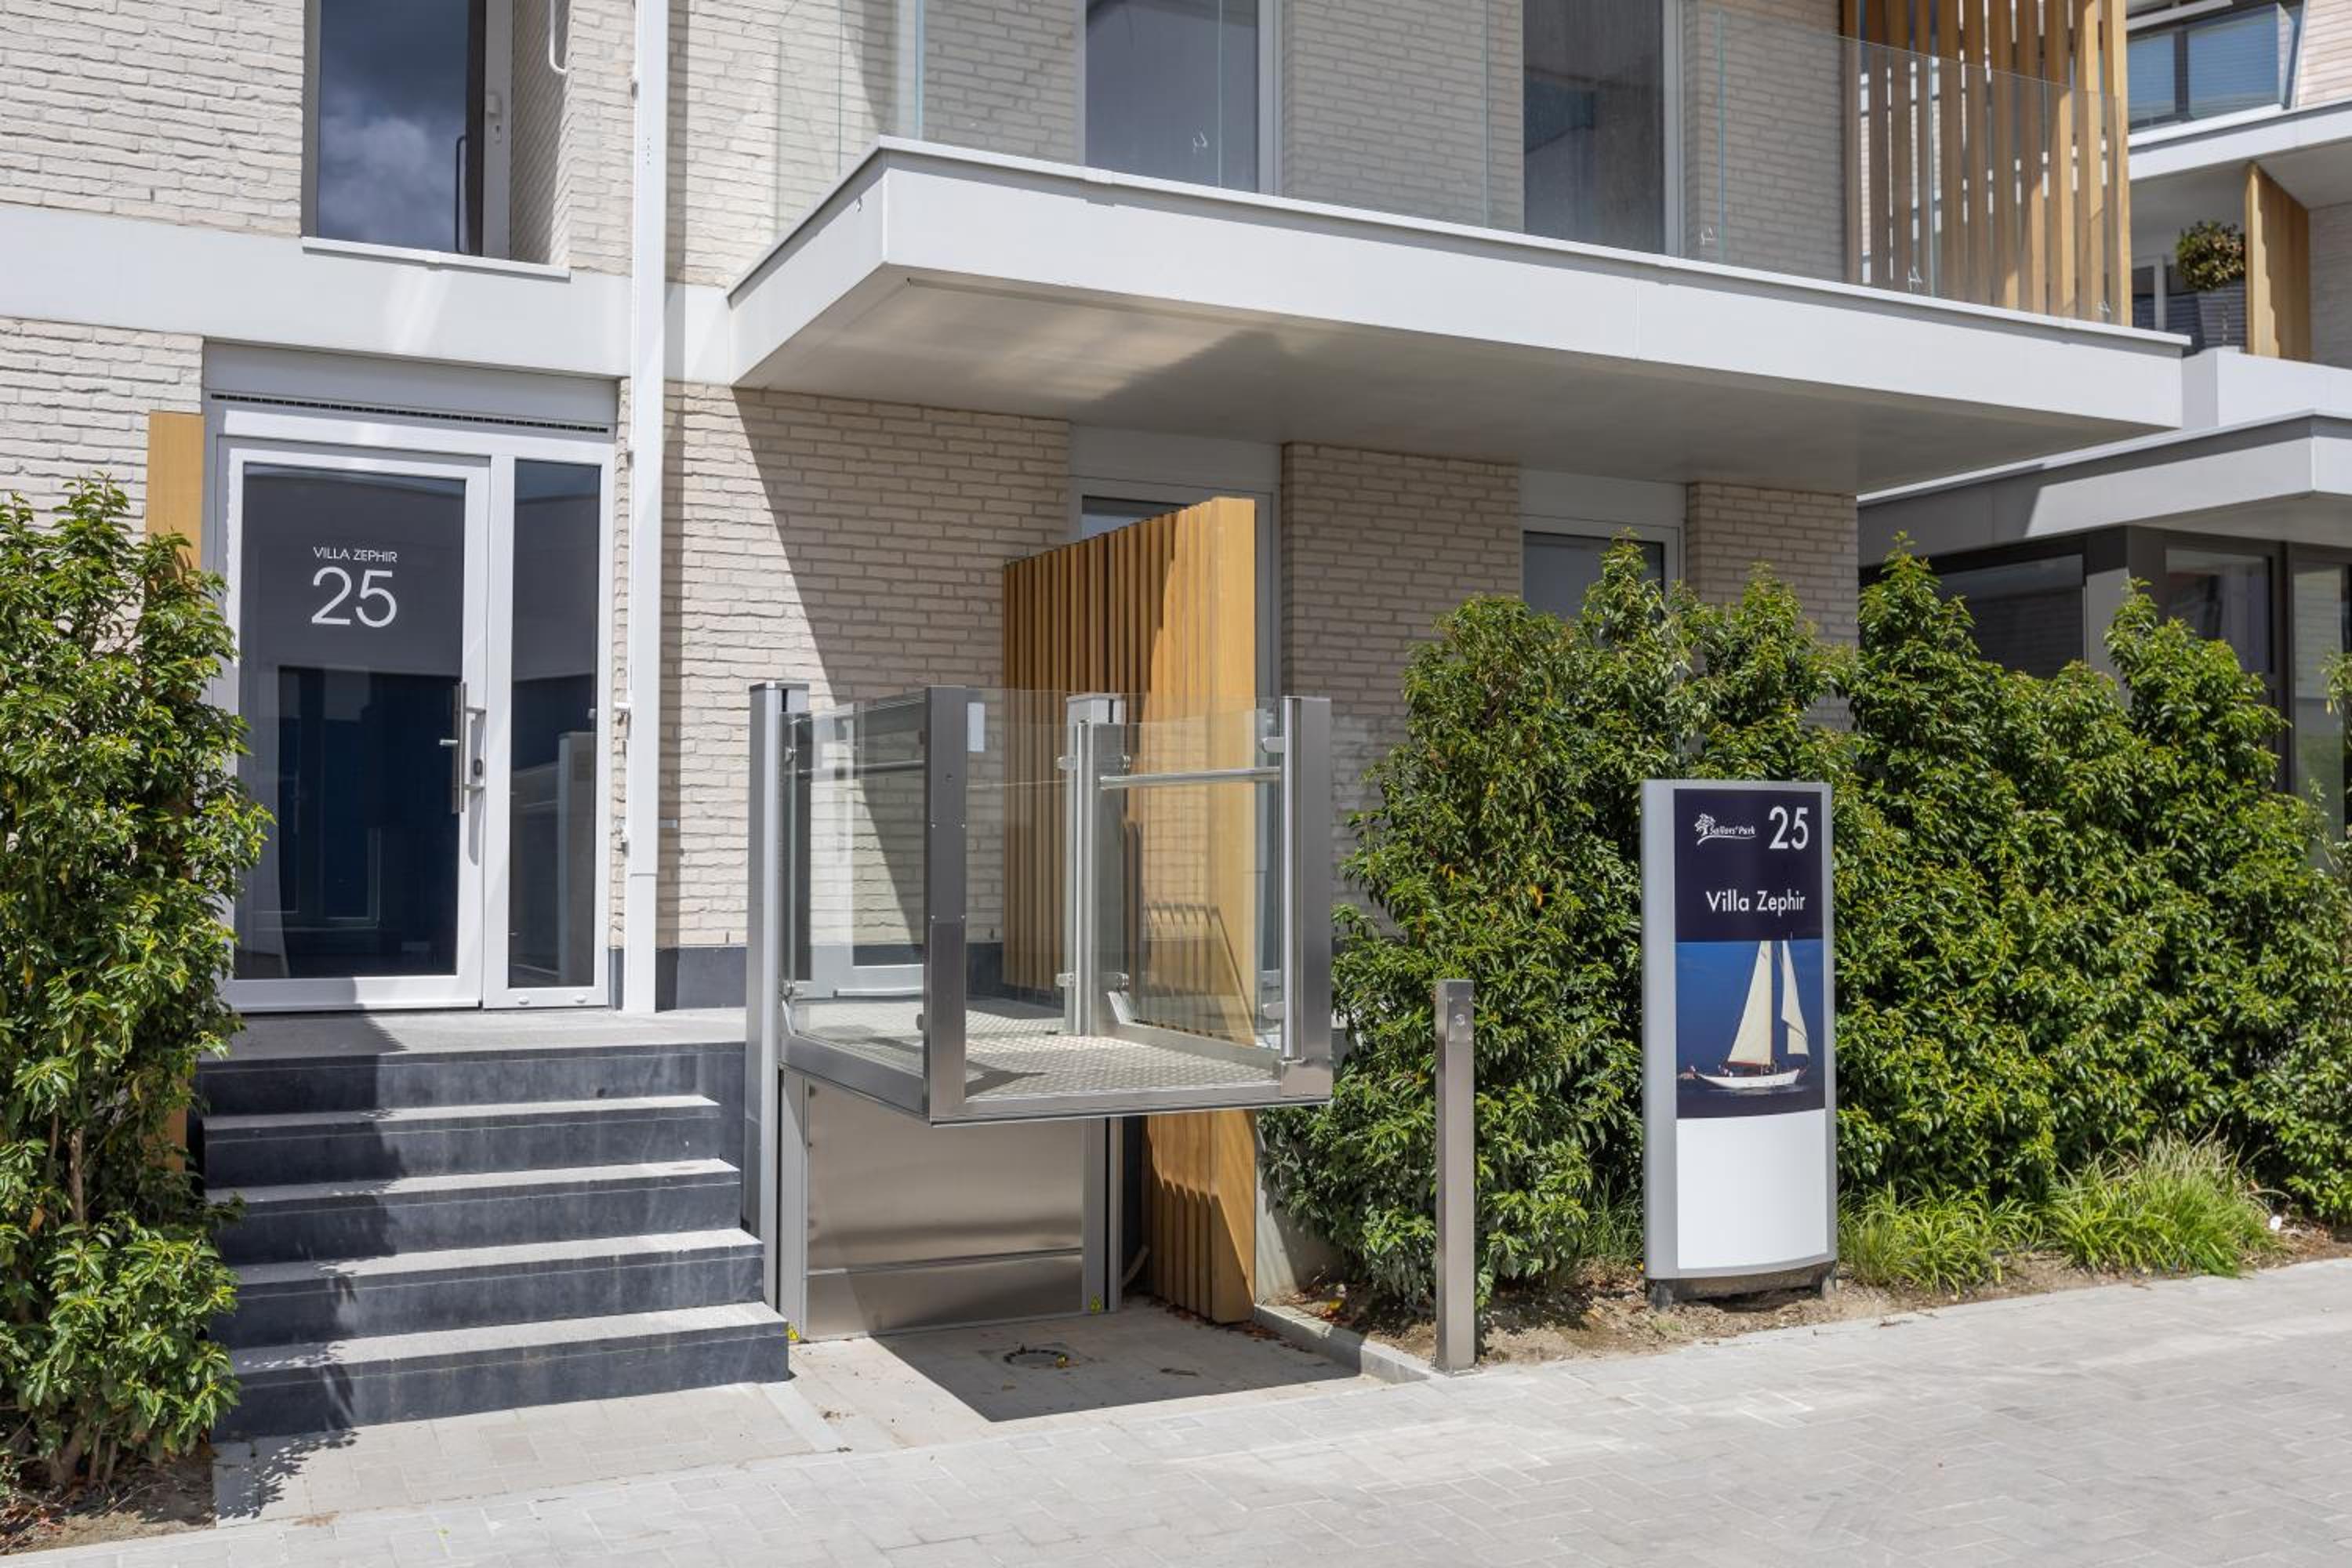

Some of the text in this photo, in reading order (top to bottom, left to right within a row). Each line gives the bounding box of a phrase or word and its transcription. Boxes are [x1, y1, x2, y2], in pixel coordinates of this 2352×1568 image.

[313, 546, 398, 563] VILLA ZEPHIR
[311, 567, 397, 627] 25
[1738, 825, 1755, 836] Park
[1768, 805, 1809, 850] 25
[1705, 888, 1806, 917] Villa Zephir
